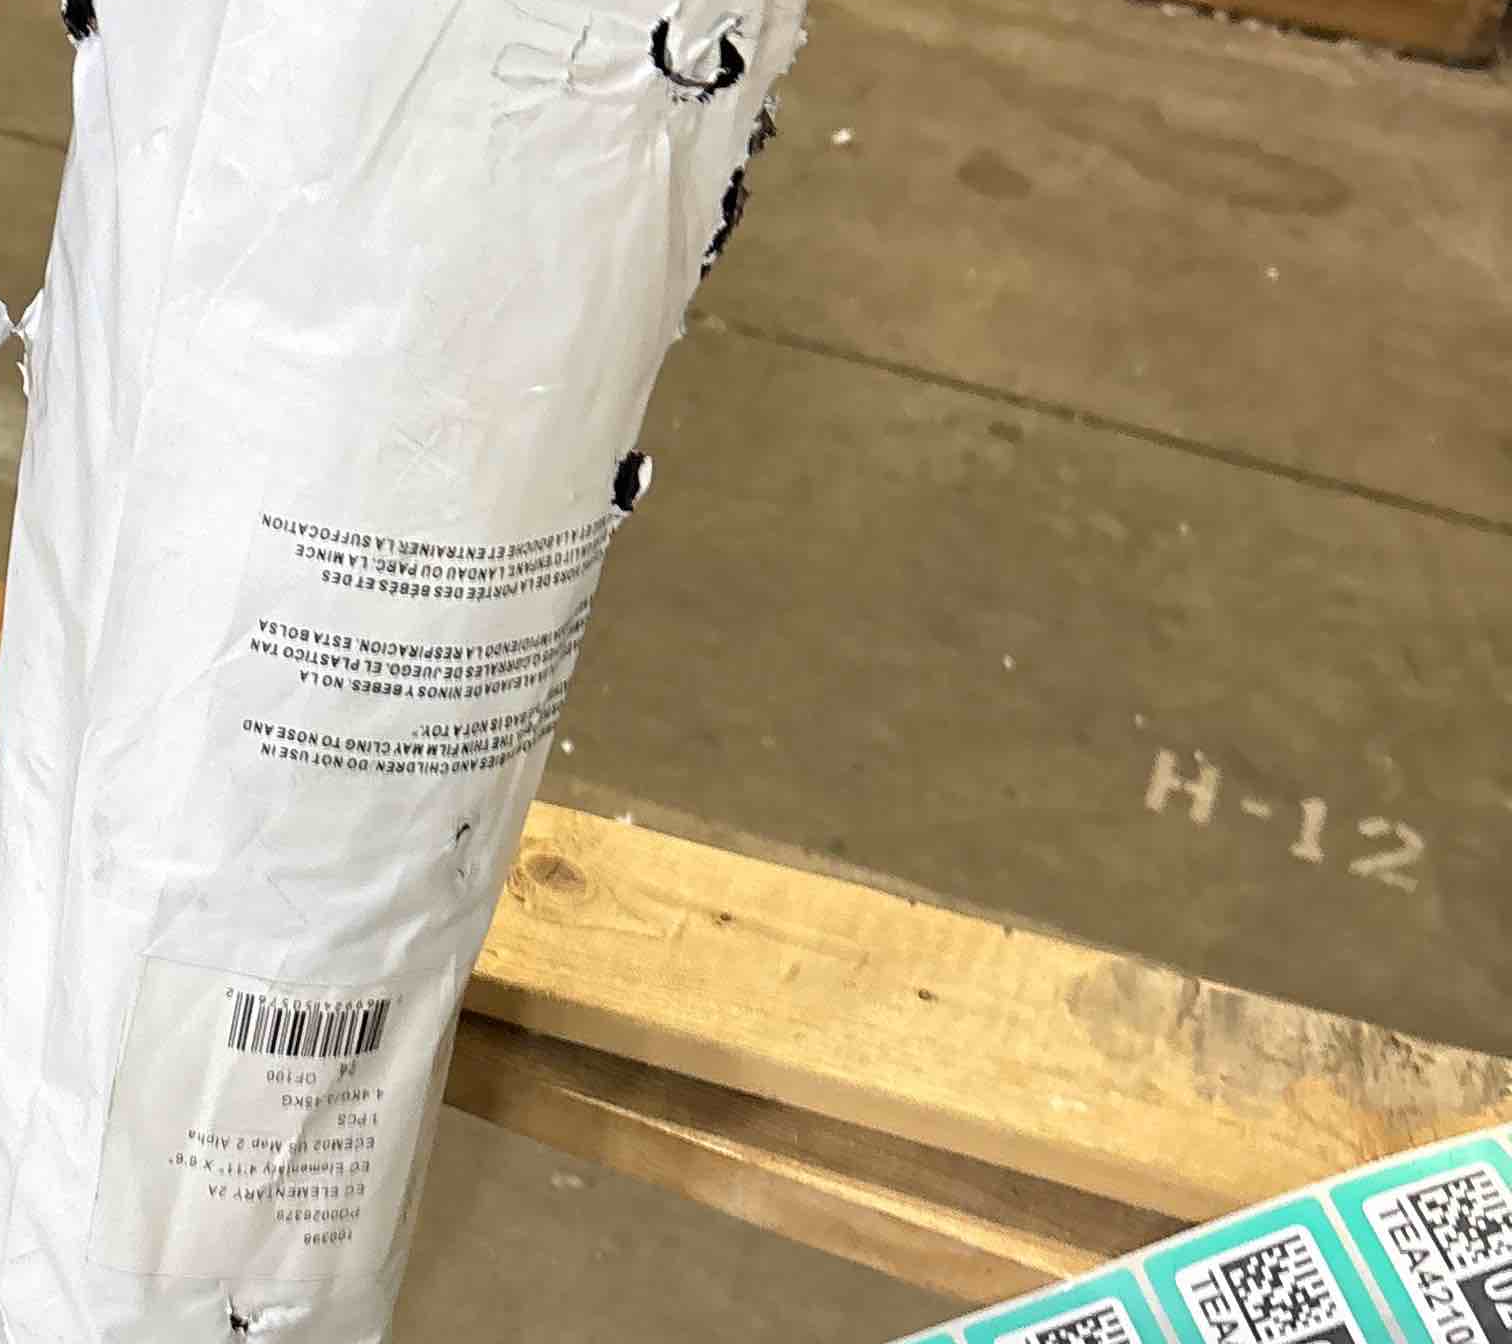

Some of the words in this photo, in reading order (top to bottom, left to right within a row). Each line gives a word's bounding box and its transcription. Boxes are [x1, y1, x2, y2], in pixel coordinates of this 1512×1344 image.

[375, 535, 395, 552] LA
[294, 543, 345, 566] MINCE
[487, 545, 507, 561] ET
[348, 553, 368, 570] LA
[321, 569, 353, 587] DES
[421, 564, 444, 579] OU
[446, 566, 505, 581] LANDAU
[354, 575, 375, 590] ET
[432, 586, 464, 601] DES
[257, 619, 310, 642] BOLSA
[249, 638, 279, 656] TAN
[313, 631, 353, 650] ESTA
[283, 646, 361, 672] PLASTICO
[466, 645, 483, 660] LA
[363, 660, 383, 675] EL
[443, 666, 464, 680] DE
[299, 669, 318, 687] LA
[322, 675, 344, 691] NO
[404, 685, 415, 697] Y
[464, 684, 484, 698] DE
[242, 719, 274, 736] AND
[276, 726, 318, 746] NOSE
[321, 735, 341, 749] TO
[260, 743, 276, 757] IN
[345, 738, 390, 755] CLING
[394, 741, 424, 756] MAY
[428, 742, 460, 757] FILM
[278, 746, 308, 764] USE
[312, 755, 343, 769] NOT
[348, 758, 368, 772] DO
[451, 759, 477, 774] AND
[187, 1129, 229, 1152] Alpha
[236, 1137, 245, 1150] 2
[251, 1137, 284, 1153] Map
[263, 1160, 345, 1177] Elementary
[232, 1185, 340, 1202] ELEMENTARY
